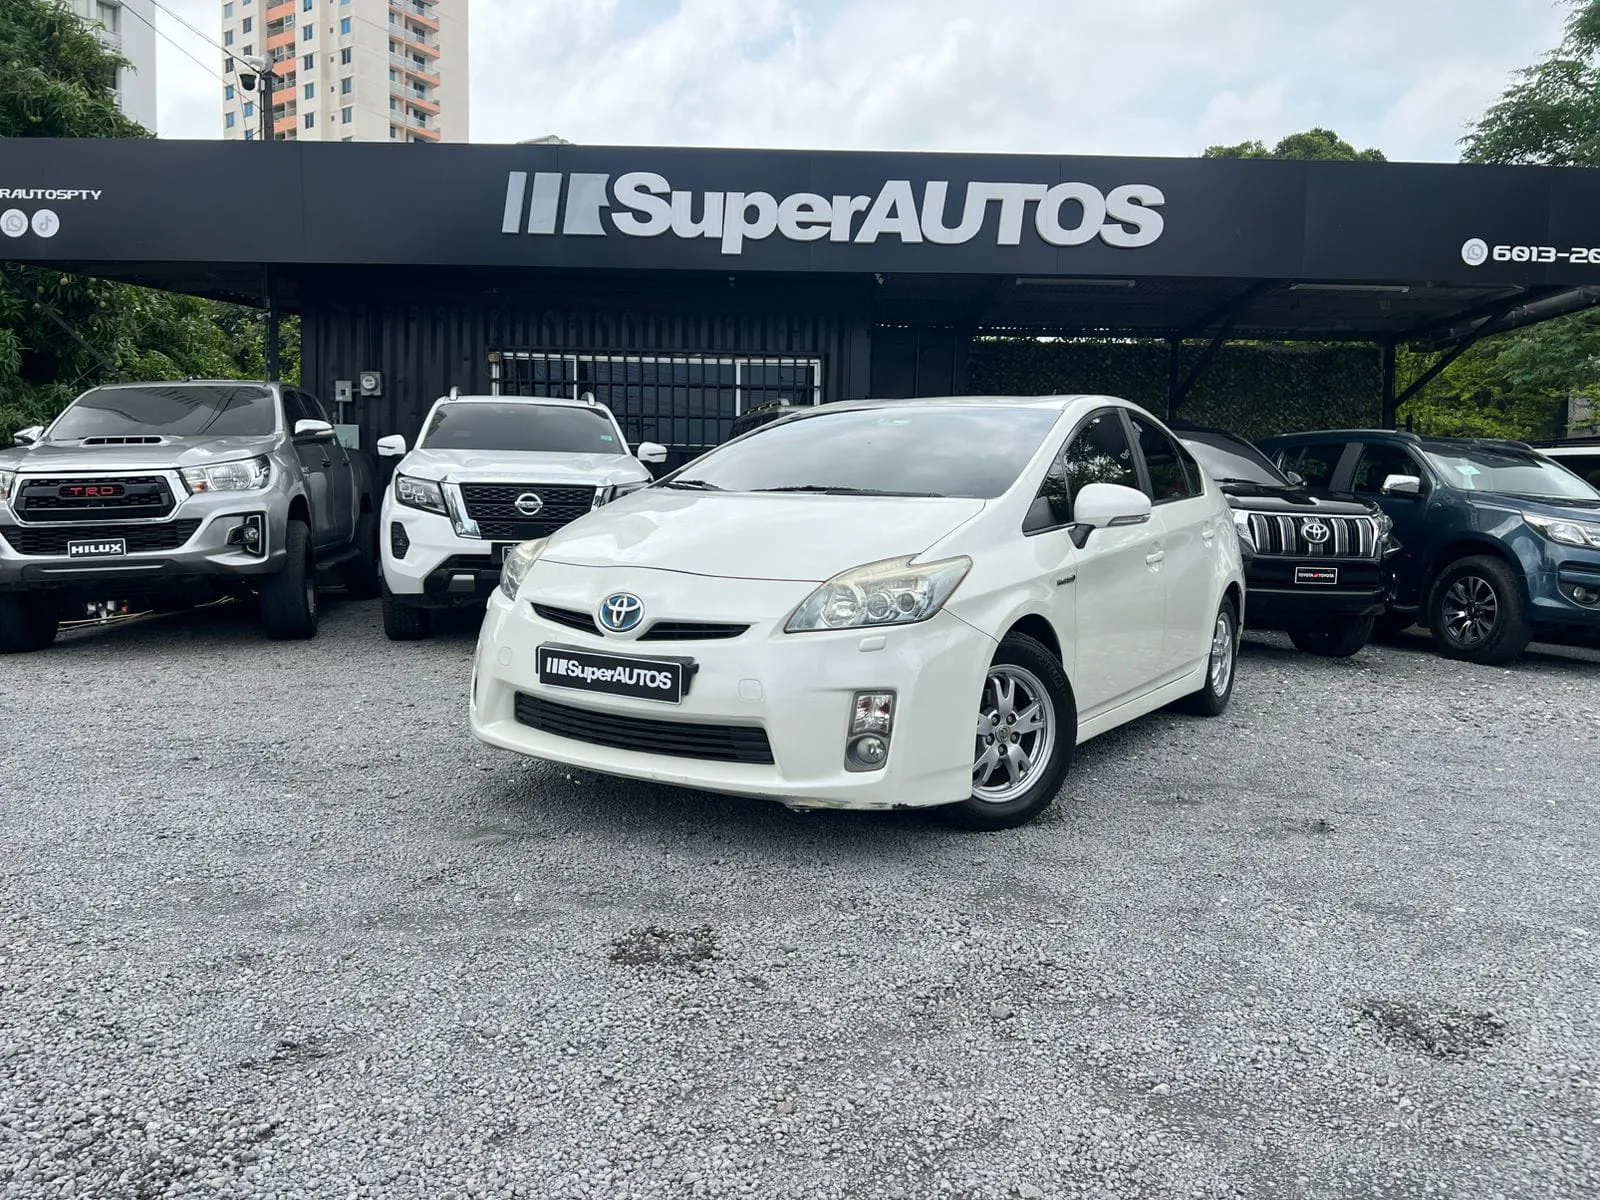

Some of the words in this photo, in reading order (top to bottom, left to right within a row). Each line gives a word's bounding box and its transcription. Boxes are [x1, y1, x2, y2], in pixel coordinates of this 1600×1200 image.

[611, 171, 1165, 255] SuperAUTOS
[70, 486, 114, 498] TRD
[71, 543, 122, 554] HILUX
[567, 660, 672, 690] SuperAUTOS
